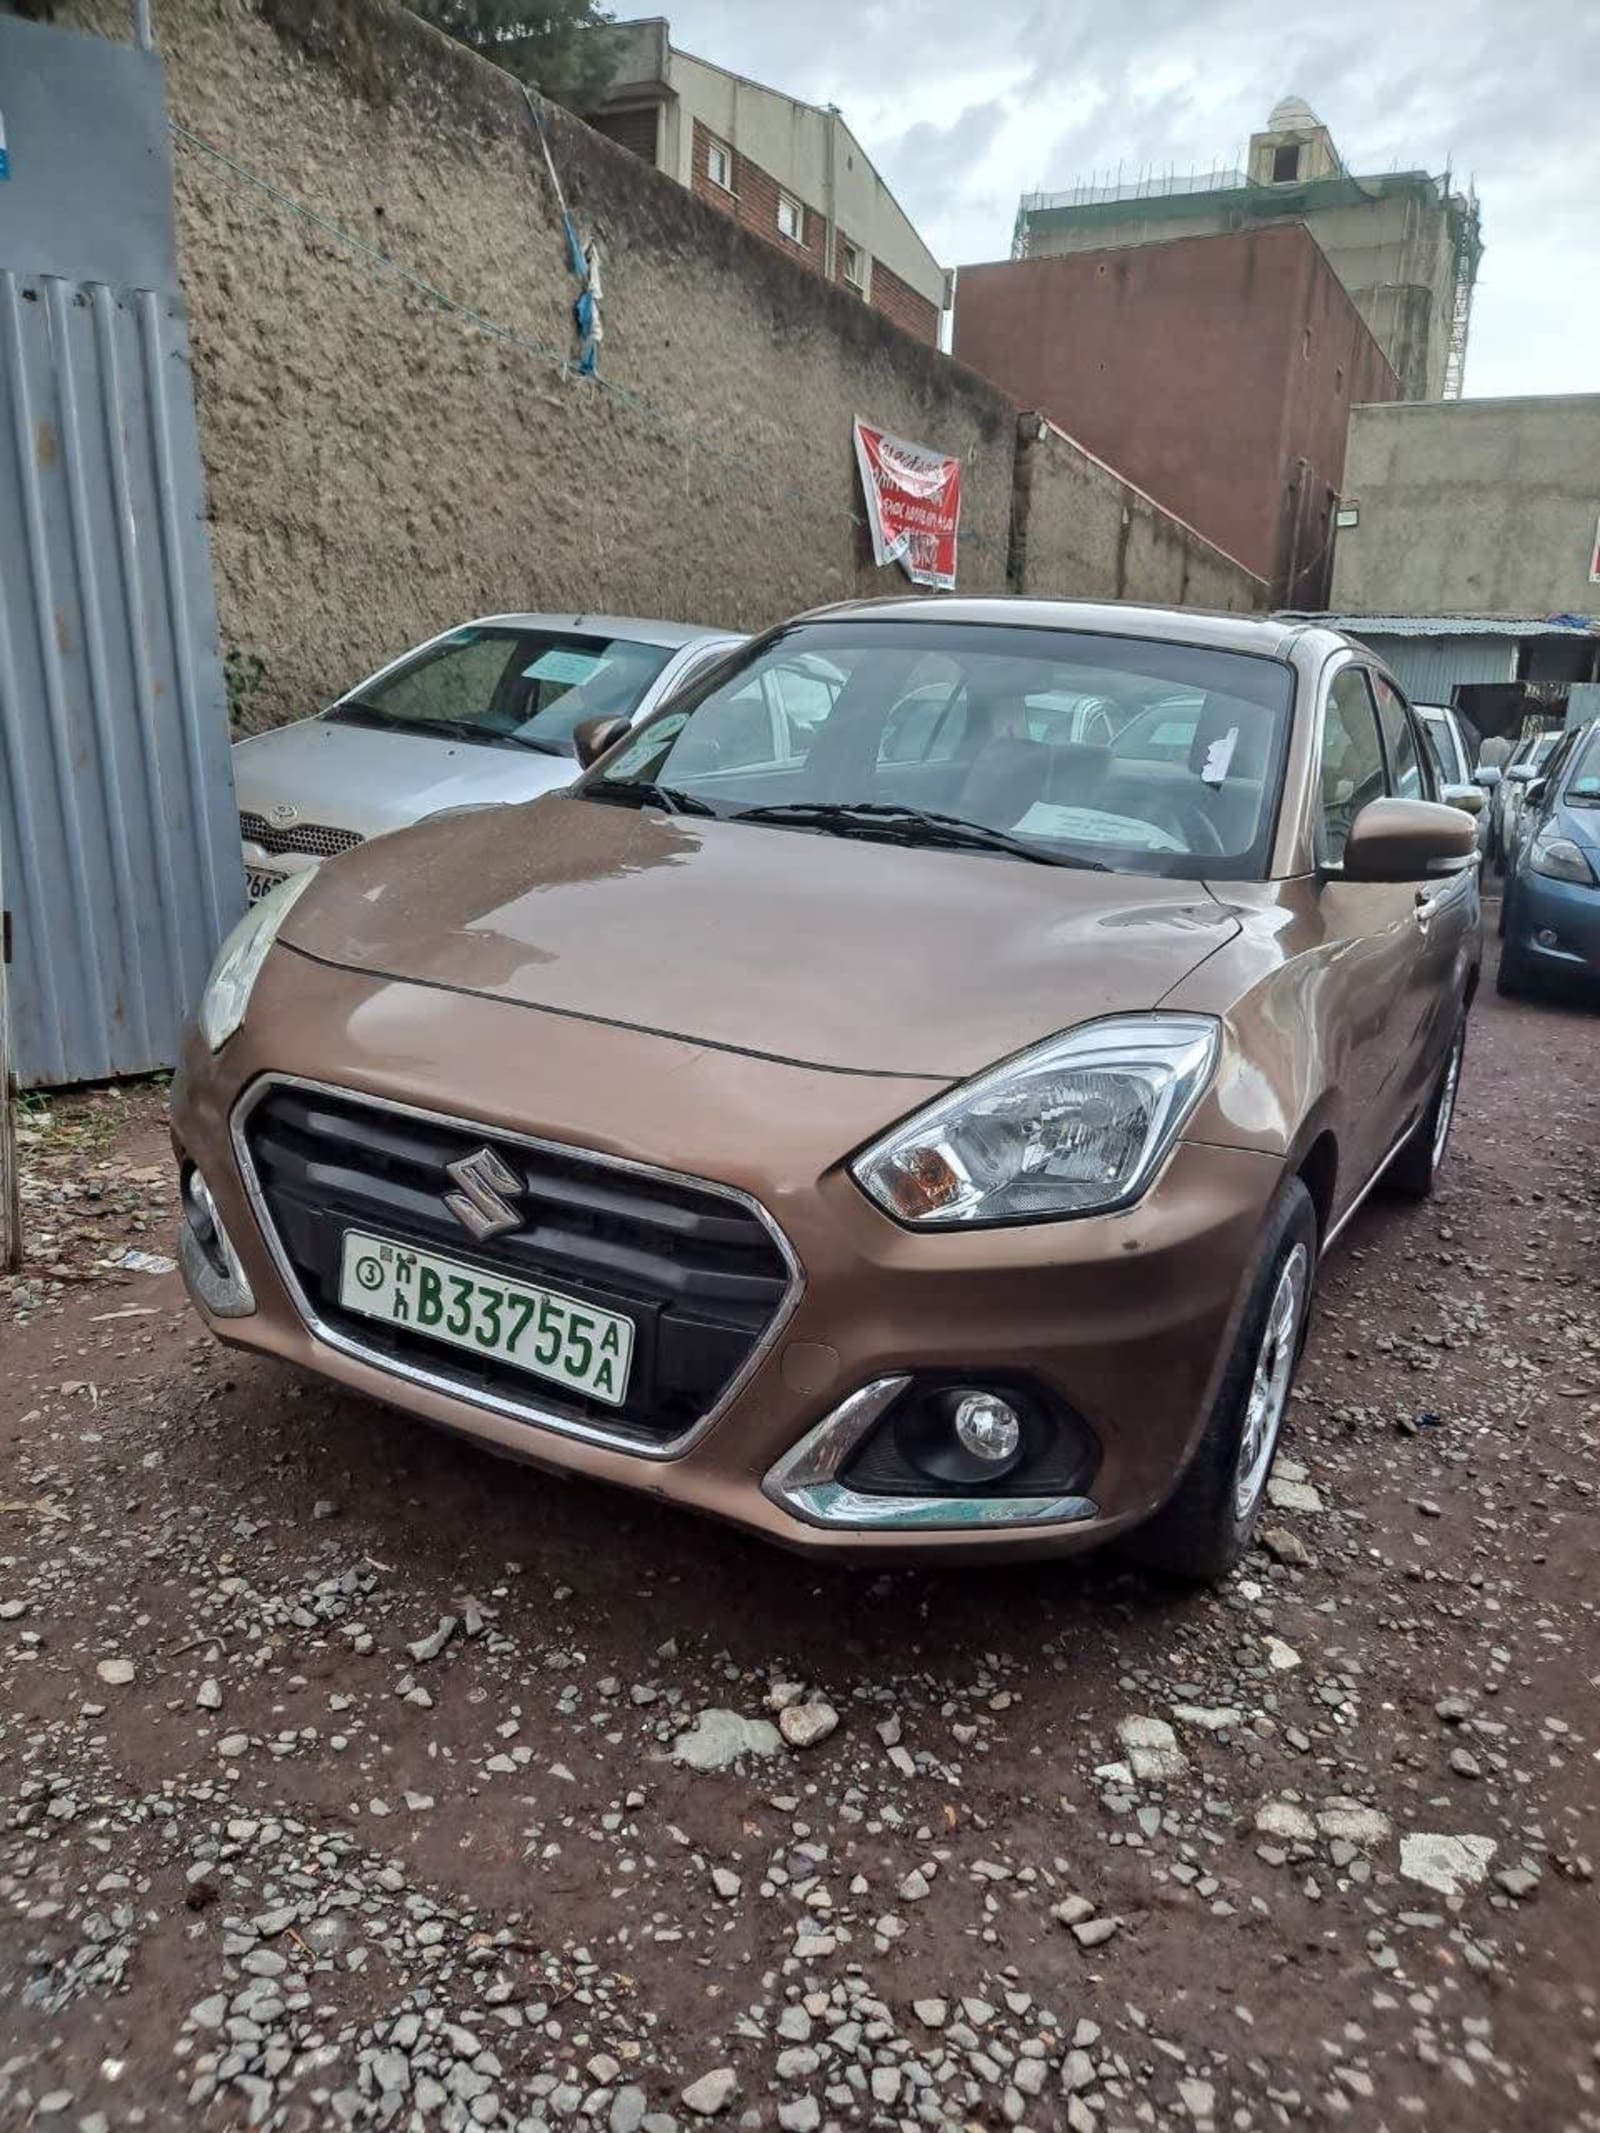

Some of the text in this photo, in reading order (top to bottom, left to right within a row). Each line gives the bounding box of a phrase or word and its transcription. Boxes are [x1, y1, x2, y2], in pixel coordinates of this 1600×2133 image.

[417, 1266, 595, 1378] B33755
[600, 1321, 619, 1356] A
[593, 1358, 612, 1393] A
